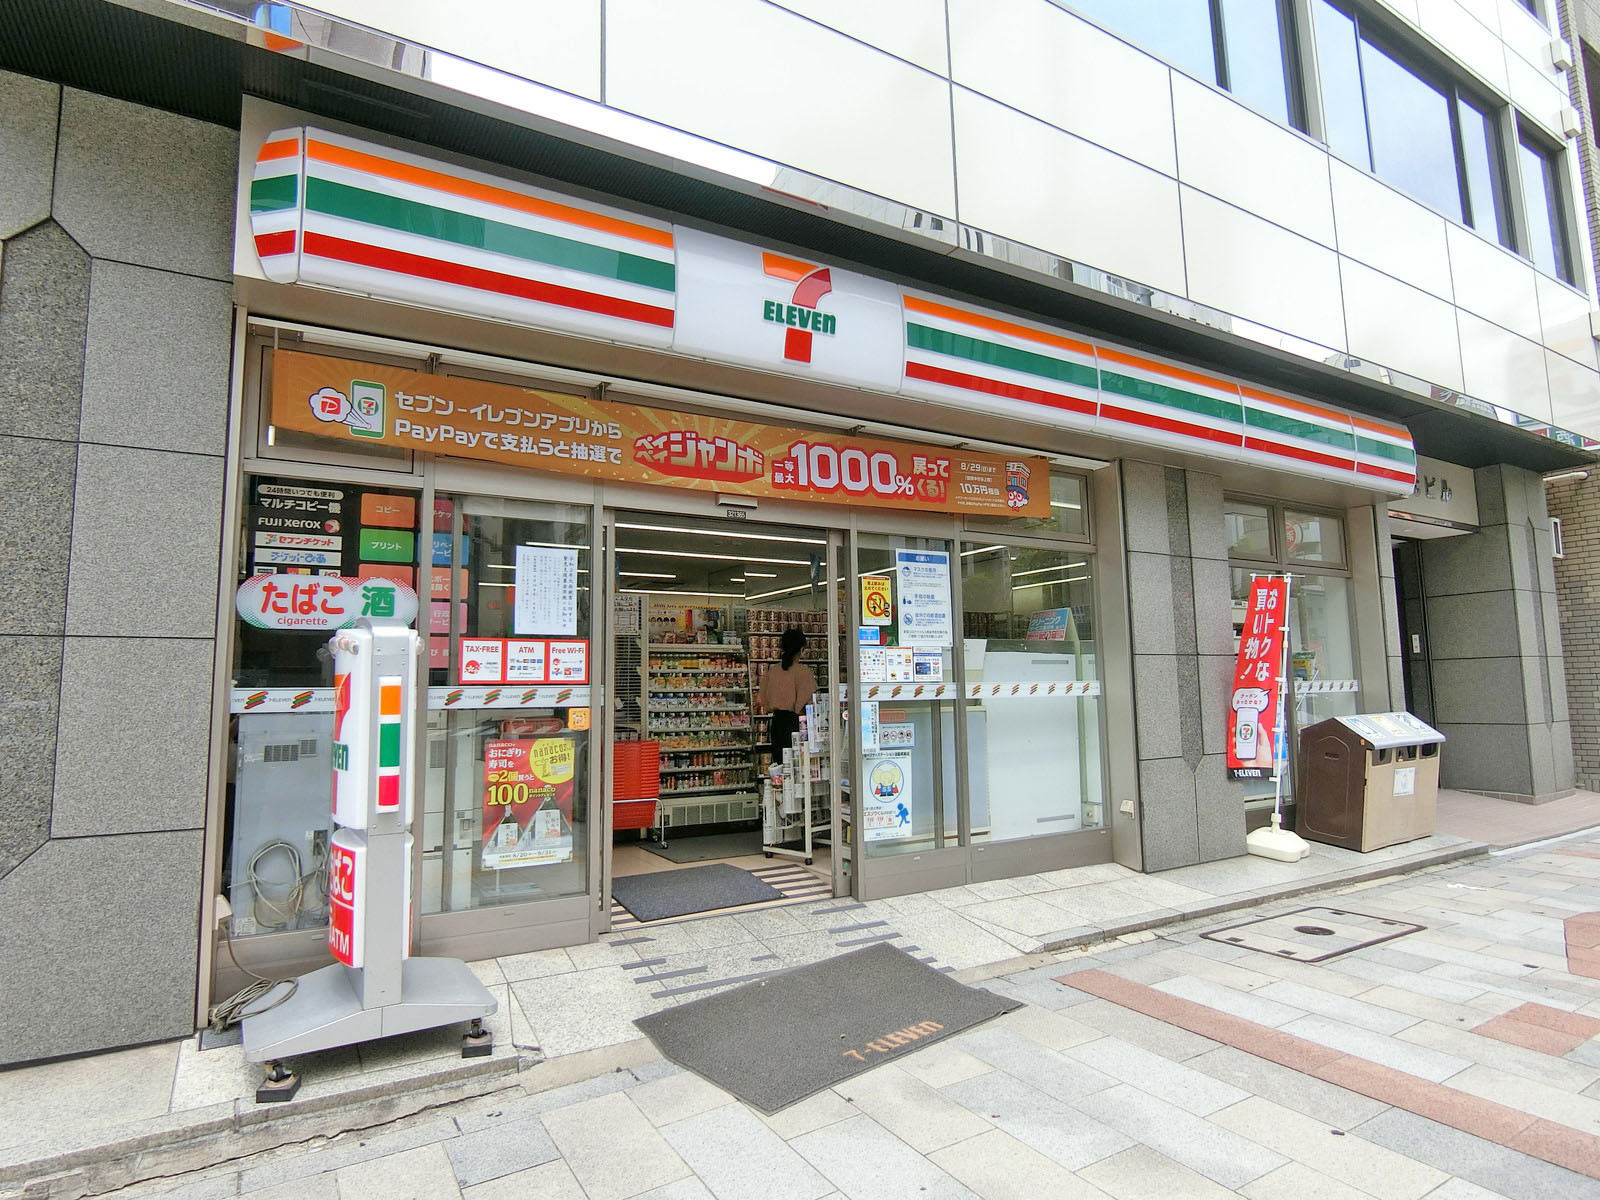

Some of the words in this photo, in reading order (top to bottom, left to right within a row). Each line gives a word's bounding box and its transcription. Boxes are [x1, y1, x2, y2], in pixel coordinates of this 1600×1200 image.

[395, 418, 622, 465] PayPayで支払うと抽選で
[791, 442, 914, 496] 1000%
[913, 456, 949, 478] 戻って
[266, 486, 336, 498] 24時間いつでも便利
[260, 497, 342, 514] マルチコピー機
[375, 505, 400, 514] コピー
[258, 517, 283, 527] FUJI
[278, 534, 334, 546] セブンチケット
[371, 541, 402, 551] プリント
[271, 551, 327, 564] チケットぴあ
[260, 581, 345, 615] たばこ
[361, 585, 396, 617] 酒
[277, 616, 328, 627] cigarette
[1256, 588, 1278, 682] おトクな
[518, 646, 535, 654] ATM
[488, 759, 515, 768] 寿司を
[488, 782, 529, 805] 100
